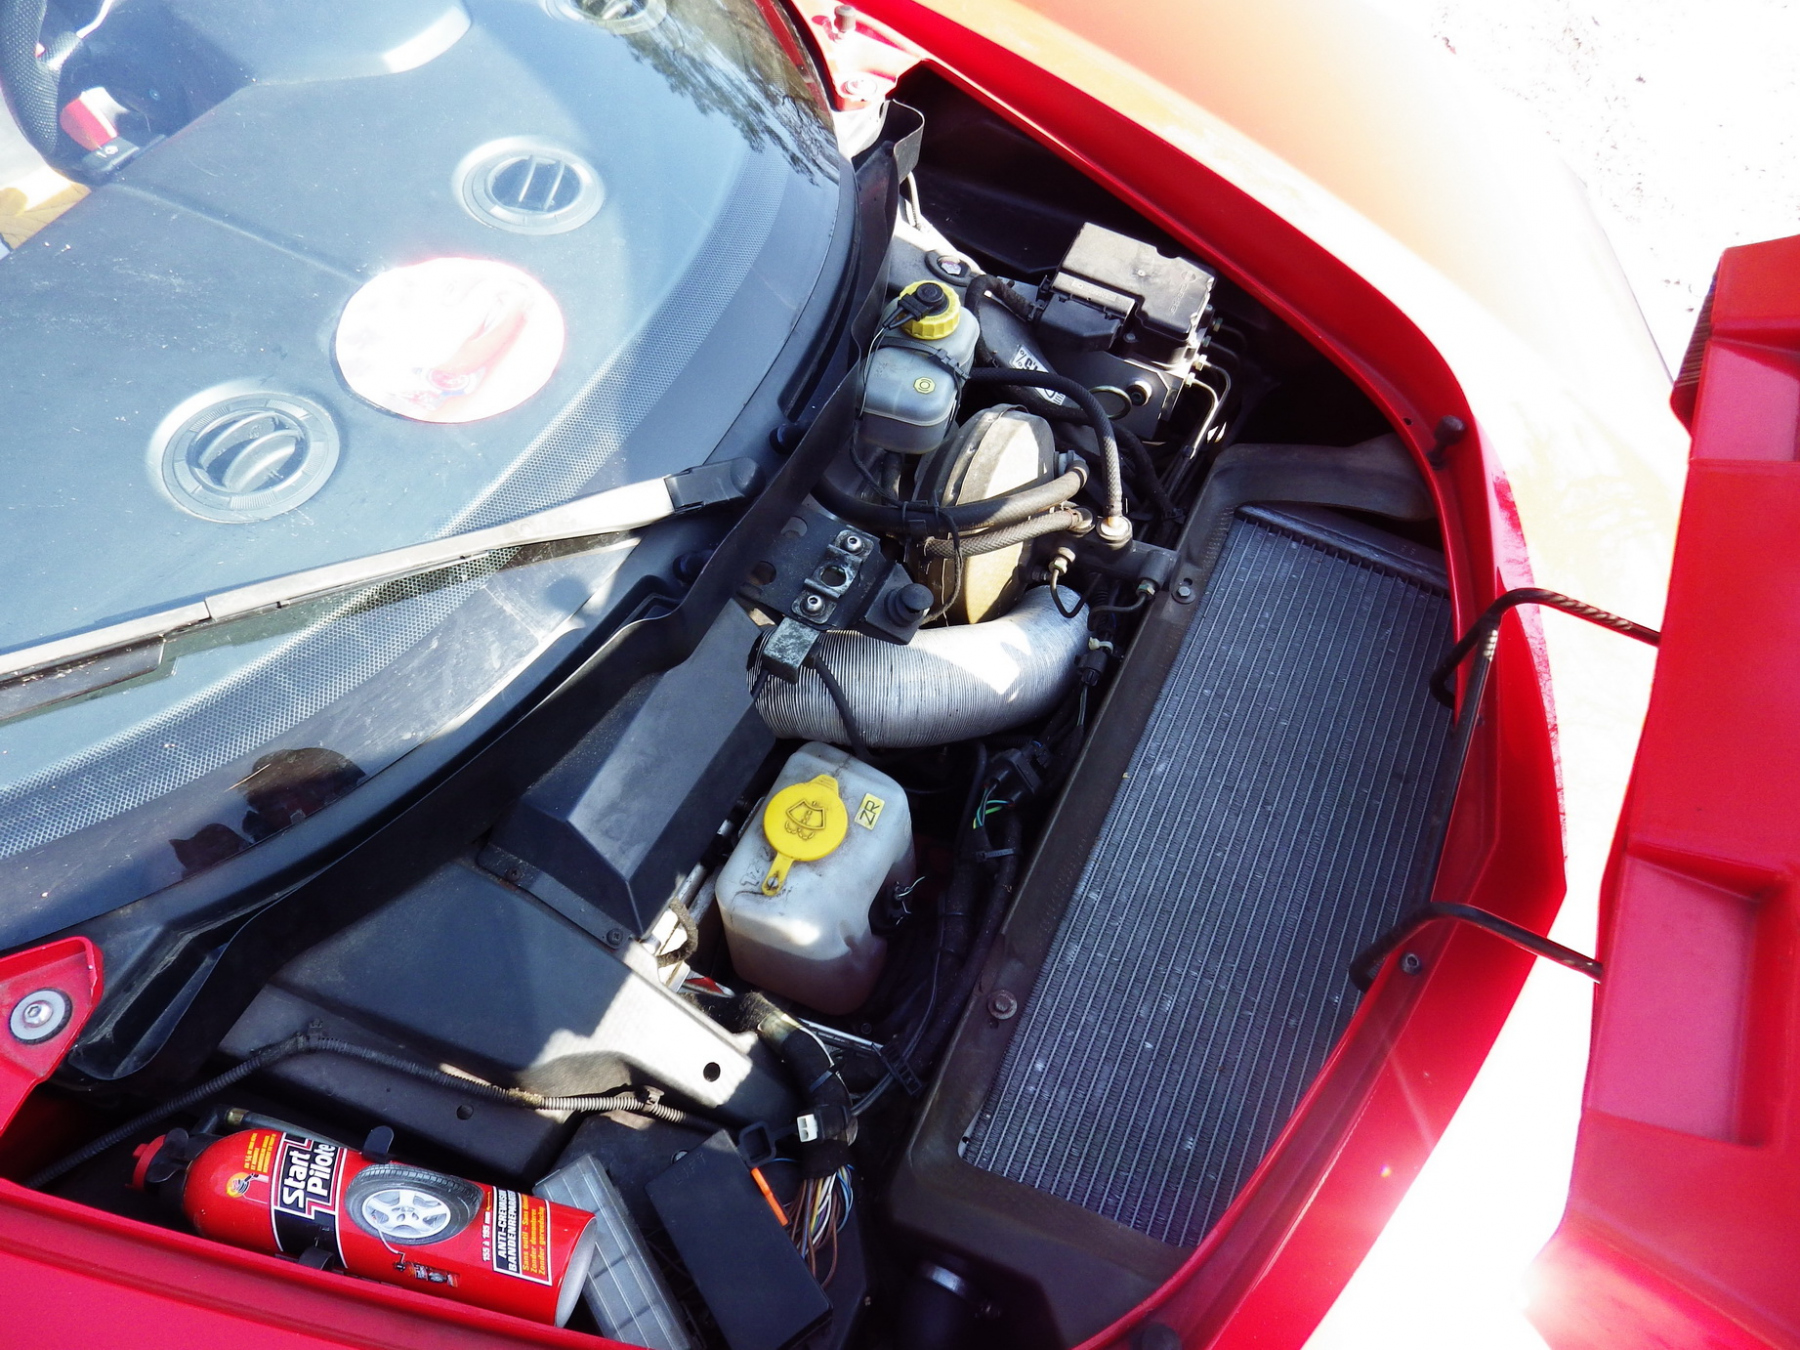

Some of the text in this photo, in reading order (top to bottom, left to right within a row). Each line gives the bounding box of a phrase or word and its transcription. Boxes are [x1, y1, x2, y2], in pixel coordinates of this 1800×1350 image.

[859, 799, 881, 826] ZR
[282, 1150, 311, 1209] Start
[306, 1143, 336, 1197] Pilote
[522, 1251, 530, 1271] Sans
[530, 1246, 538, 1273] Zonder
[538, 1246, 546, 1276] Zonder
